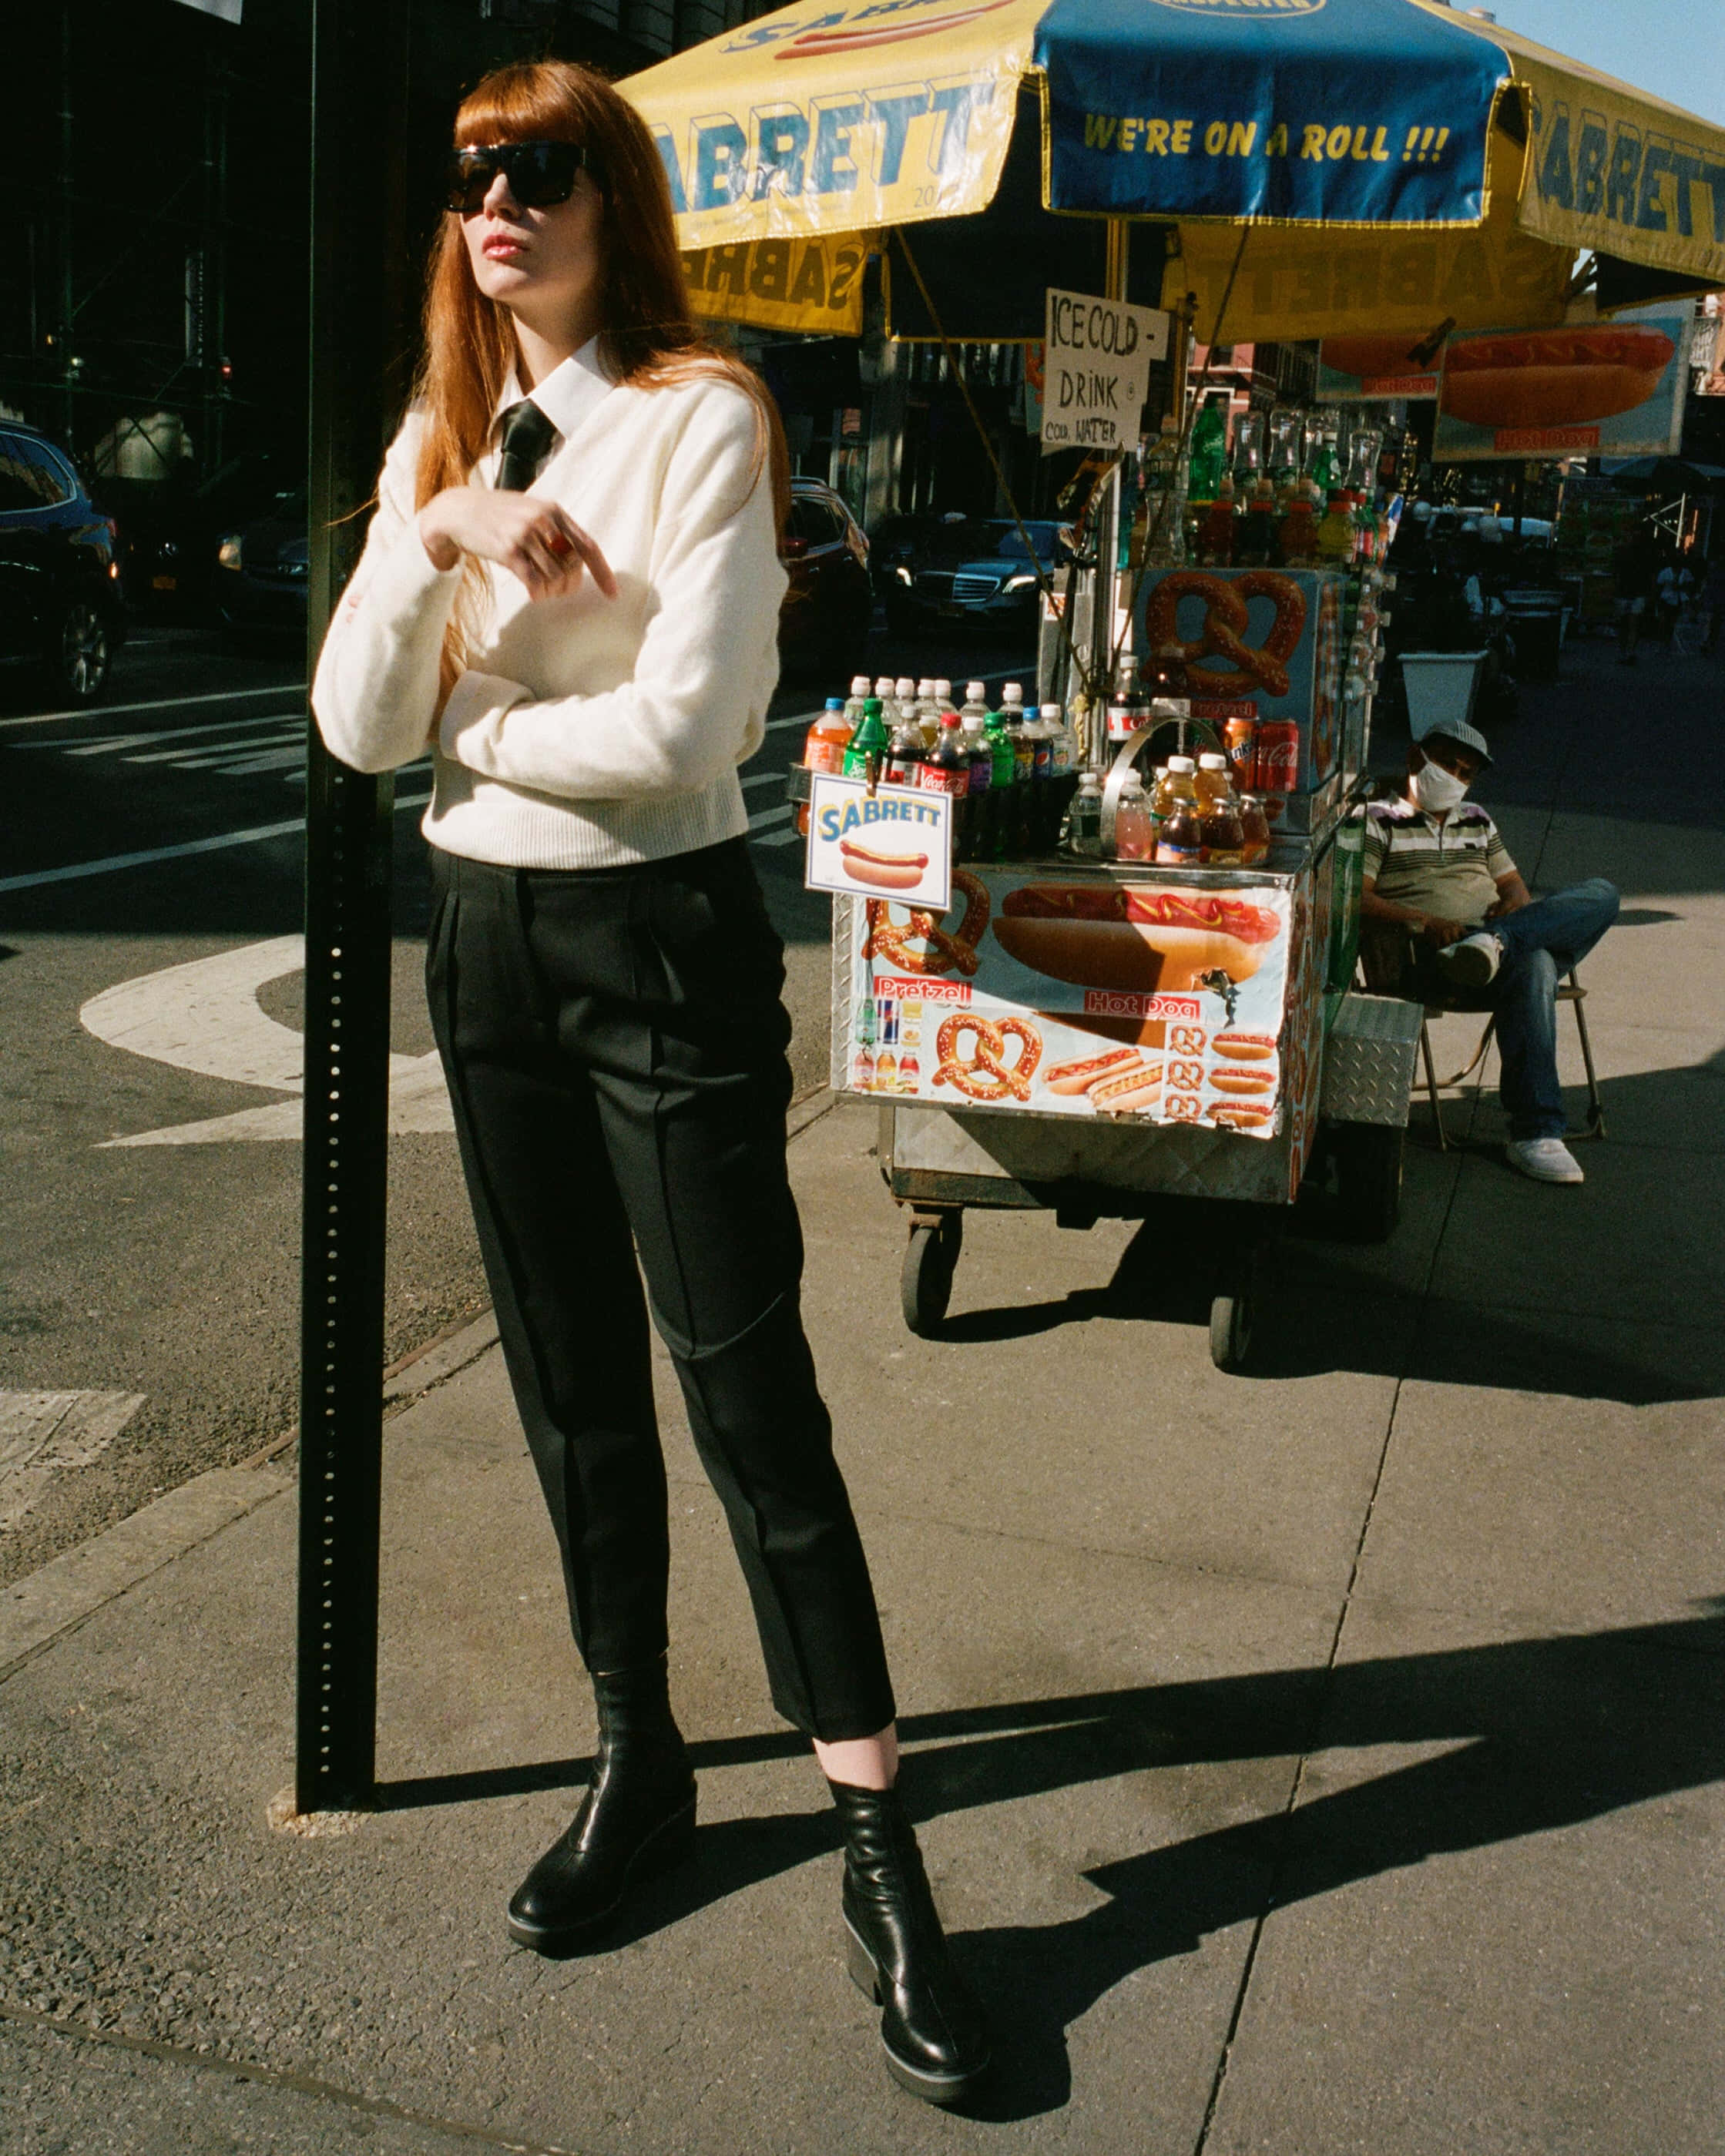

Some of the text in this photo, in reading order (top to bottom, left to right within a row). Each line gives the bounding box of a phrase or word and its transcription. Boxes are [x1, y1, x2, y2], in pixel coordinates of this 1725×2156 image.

[1085, 114, 1450, 163] WE'RE ON A ROLL !!!
[1051, 295, 1086, 349] ICE
[818, 796, 941, 842] SABRETT
[879, 977, 967, 1004] Pretzel
[1088, 991, 1196, 1021] Hot Dog
